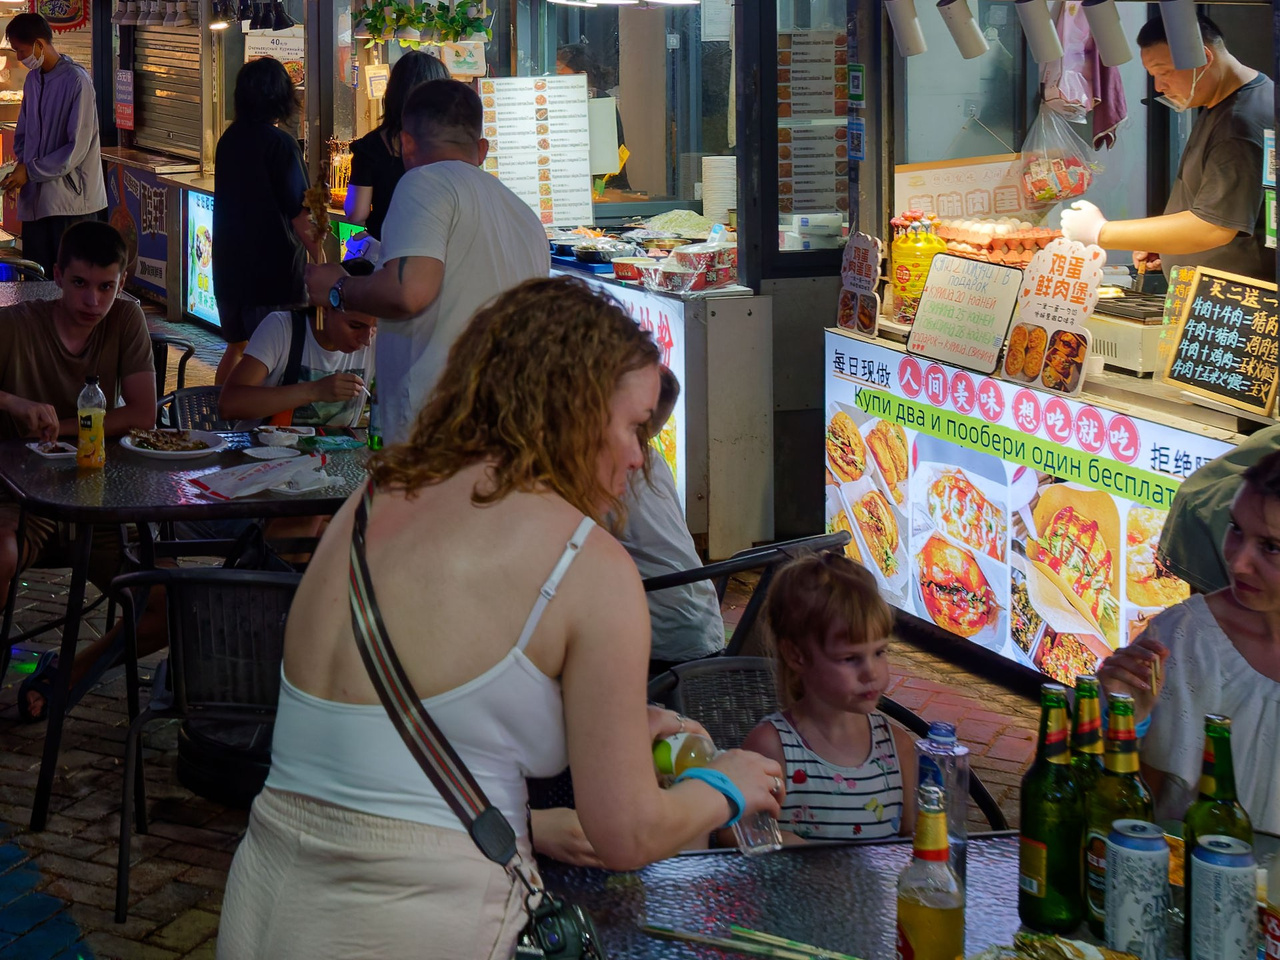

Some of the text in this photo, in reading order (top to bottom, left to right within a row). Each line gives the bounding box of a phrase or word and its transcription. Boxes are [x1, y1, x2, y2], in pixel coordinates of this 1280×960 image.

[141, 180, 168, 235] 酸辣
[1048, 252, 1086, 280] 鸡蛋
[1034, 274, 1089, 306] 鲜肉堡
[832, 348, 891, 388] 每日现做
[854, 385, 892, 416] Купи
[895, 401, 926, 428] два
[930, 412, 942, 432] и
[946, 418, 1026, 459] пообери
[1031, 445, 1081, 478] один
[900, 360, 1135, 458] 人间美味 想吃就吃
